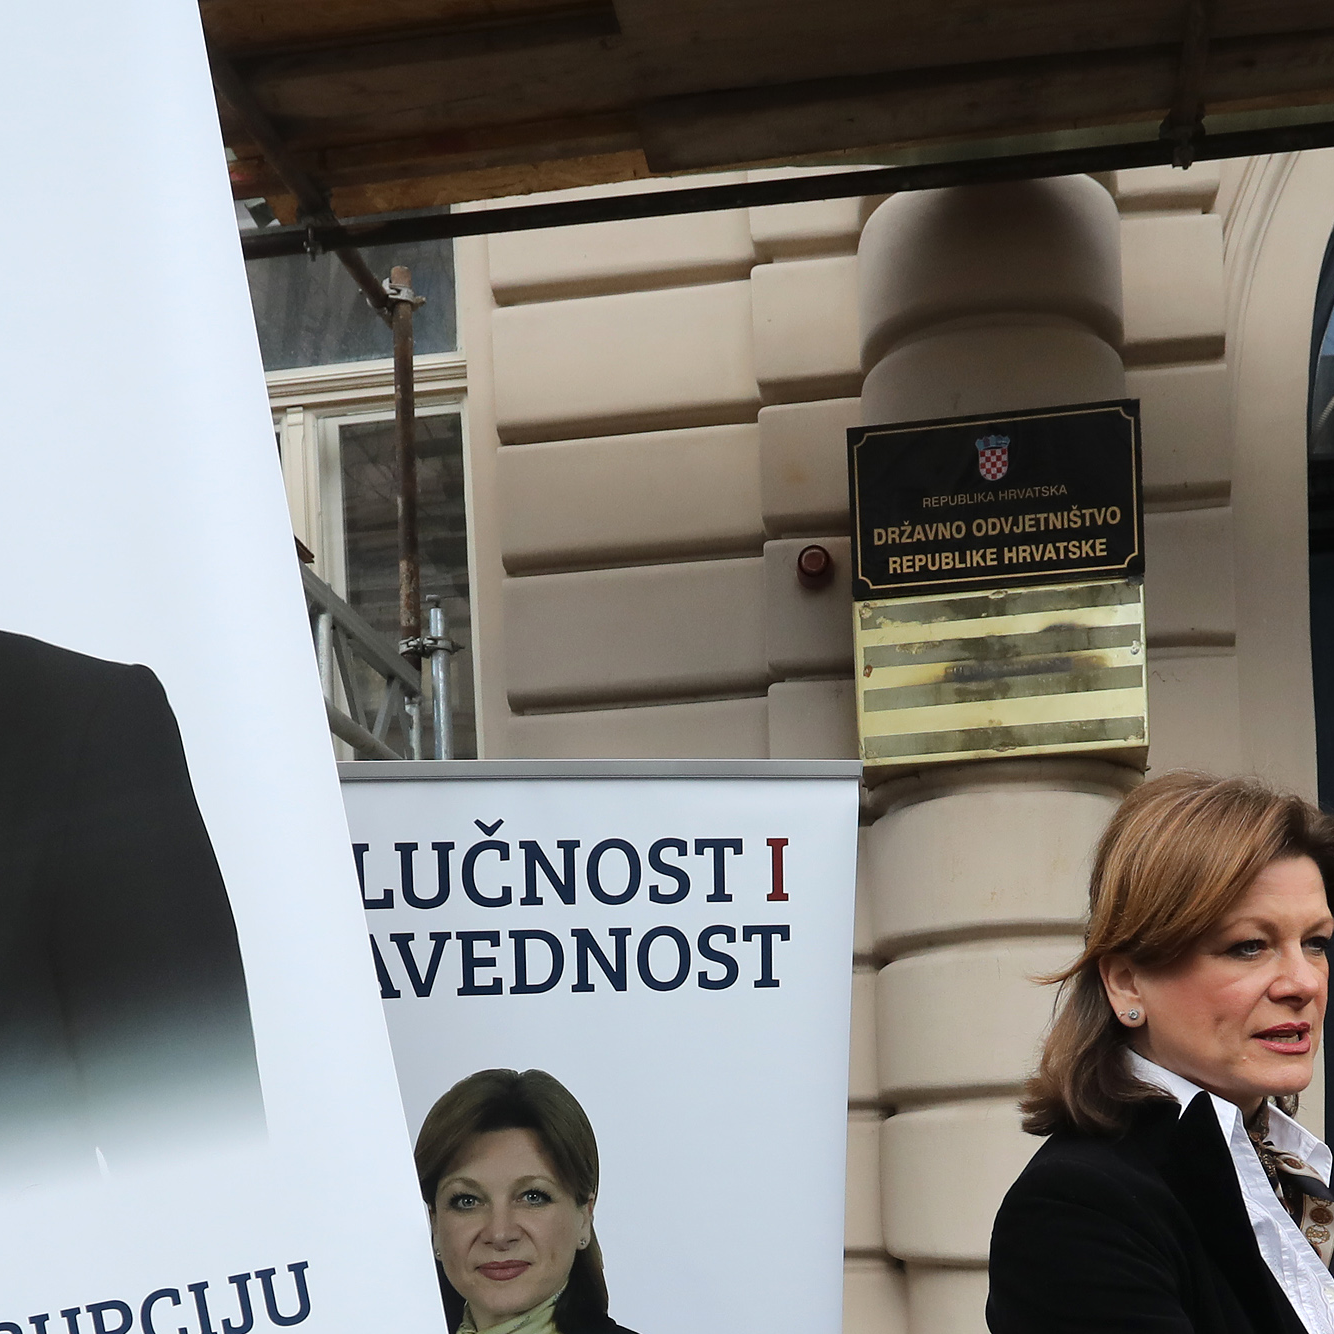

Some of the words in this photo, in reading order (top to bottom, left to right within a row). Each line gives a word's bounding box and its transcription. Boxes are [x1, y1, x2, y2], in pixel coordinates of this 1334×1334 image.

[922, 491, 995, 508] REPUBLIKA
[999, 484, 1068, 501] HRVATSKA
[873, 519, 966, 546] DRŽAVNO
[972, 505, 1122, 537] ODVJETNIŠTVO
[888, 548, 998, 574] REPUBLIKE
[1003, 538, 1108, 565] HRVATSKE
[766, 837, 789, 902] I
